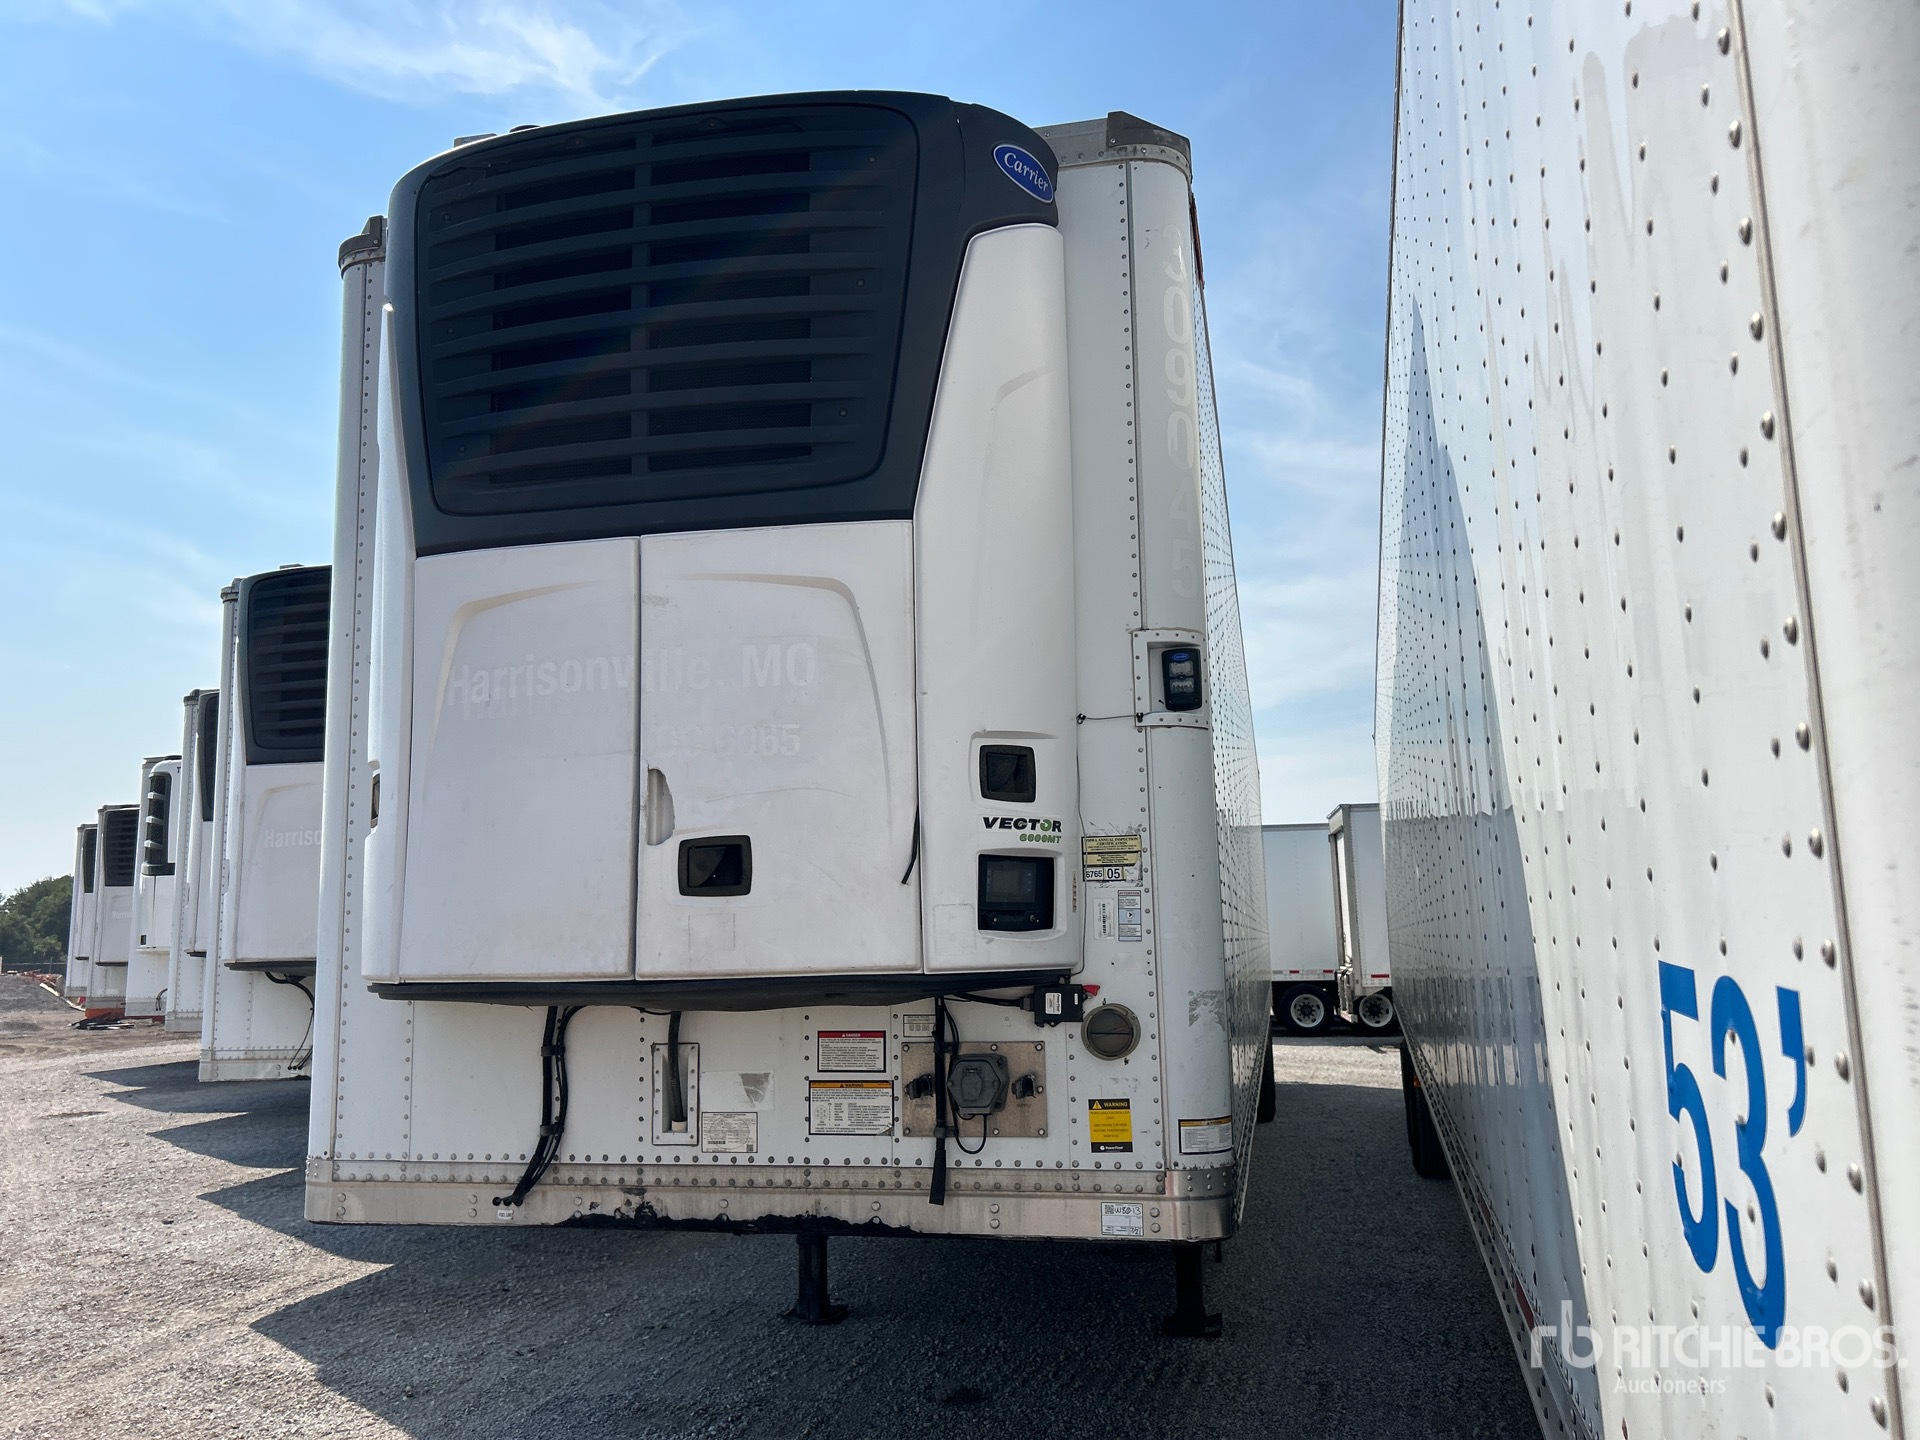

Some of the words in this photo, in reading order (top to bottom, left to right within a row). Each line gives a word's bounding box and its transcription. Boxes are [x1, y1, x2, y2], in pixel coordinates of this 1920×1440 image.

[1003, 152, 1049, 192] Carrier
[741, 642, 815, 688] MO
[983, 816, 1062, 833] VECTOR
[1106, 868, 1121, 879] 05
